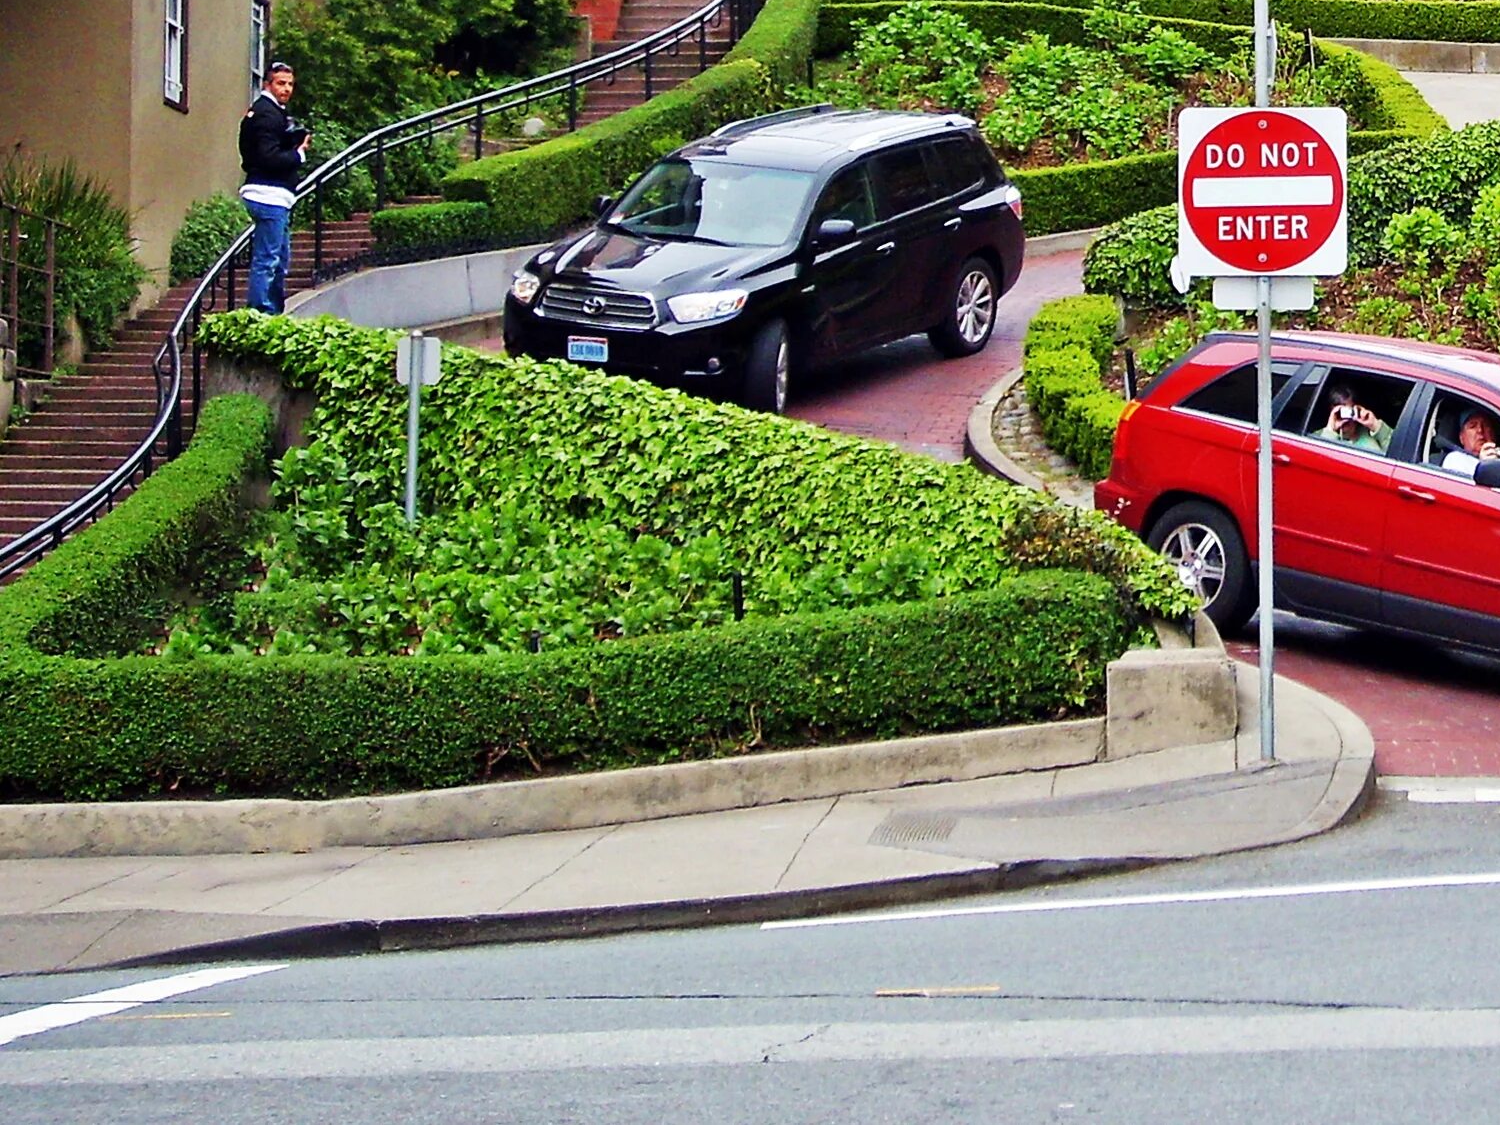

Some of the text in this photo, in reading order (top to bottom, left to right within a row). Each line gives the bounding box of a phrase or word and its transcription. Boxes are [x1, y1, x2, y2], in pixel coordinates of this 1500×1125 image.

[1205, 142, 1319, 169] DO NOT
[1217, 214, 1309, 241] ENTER
